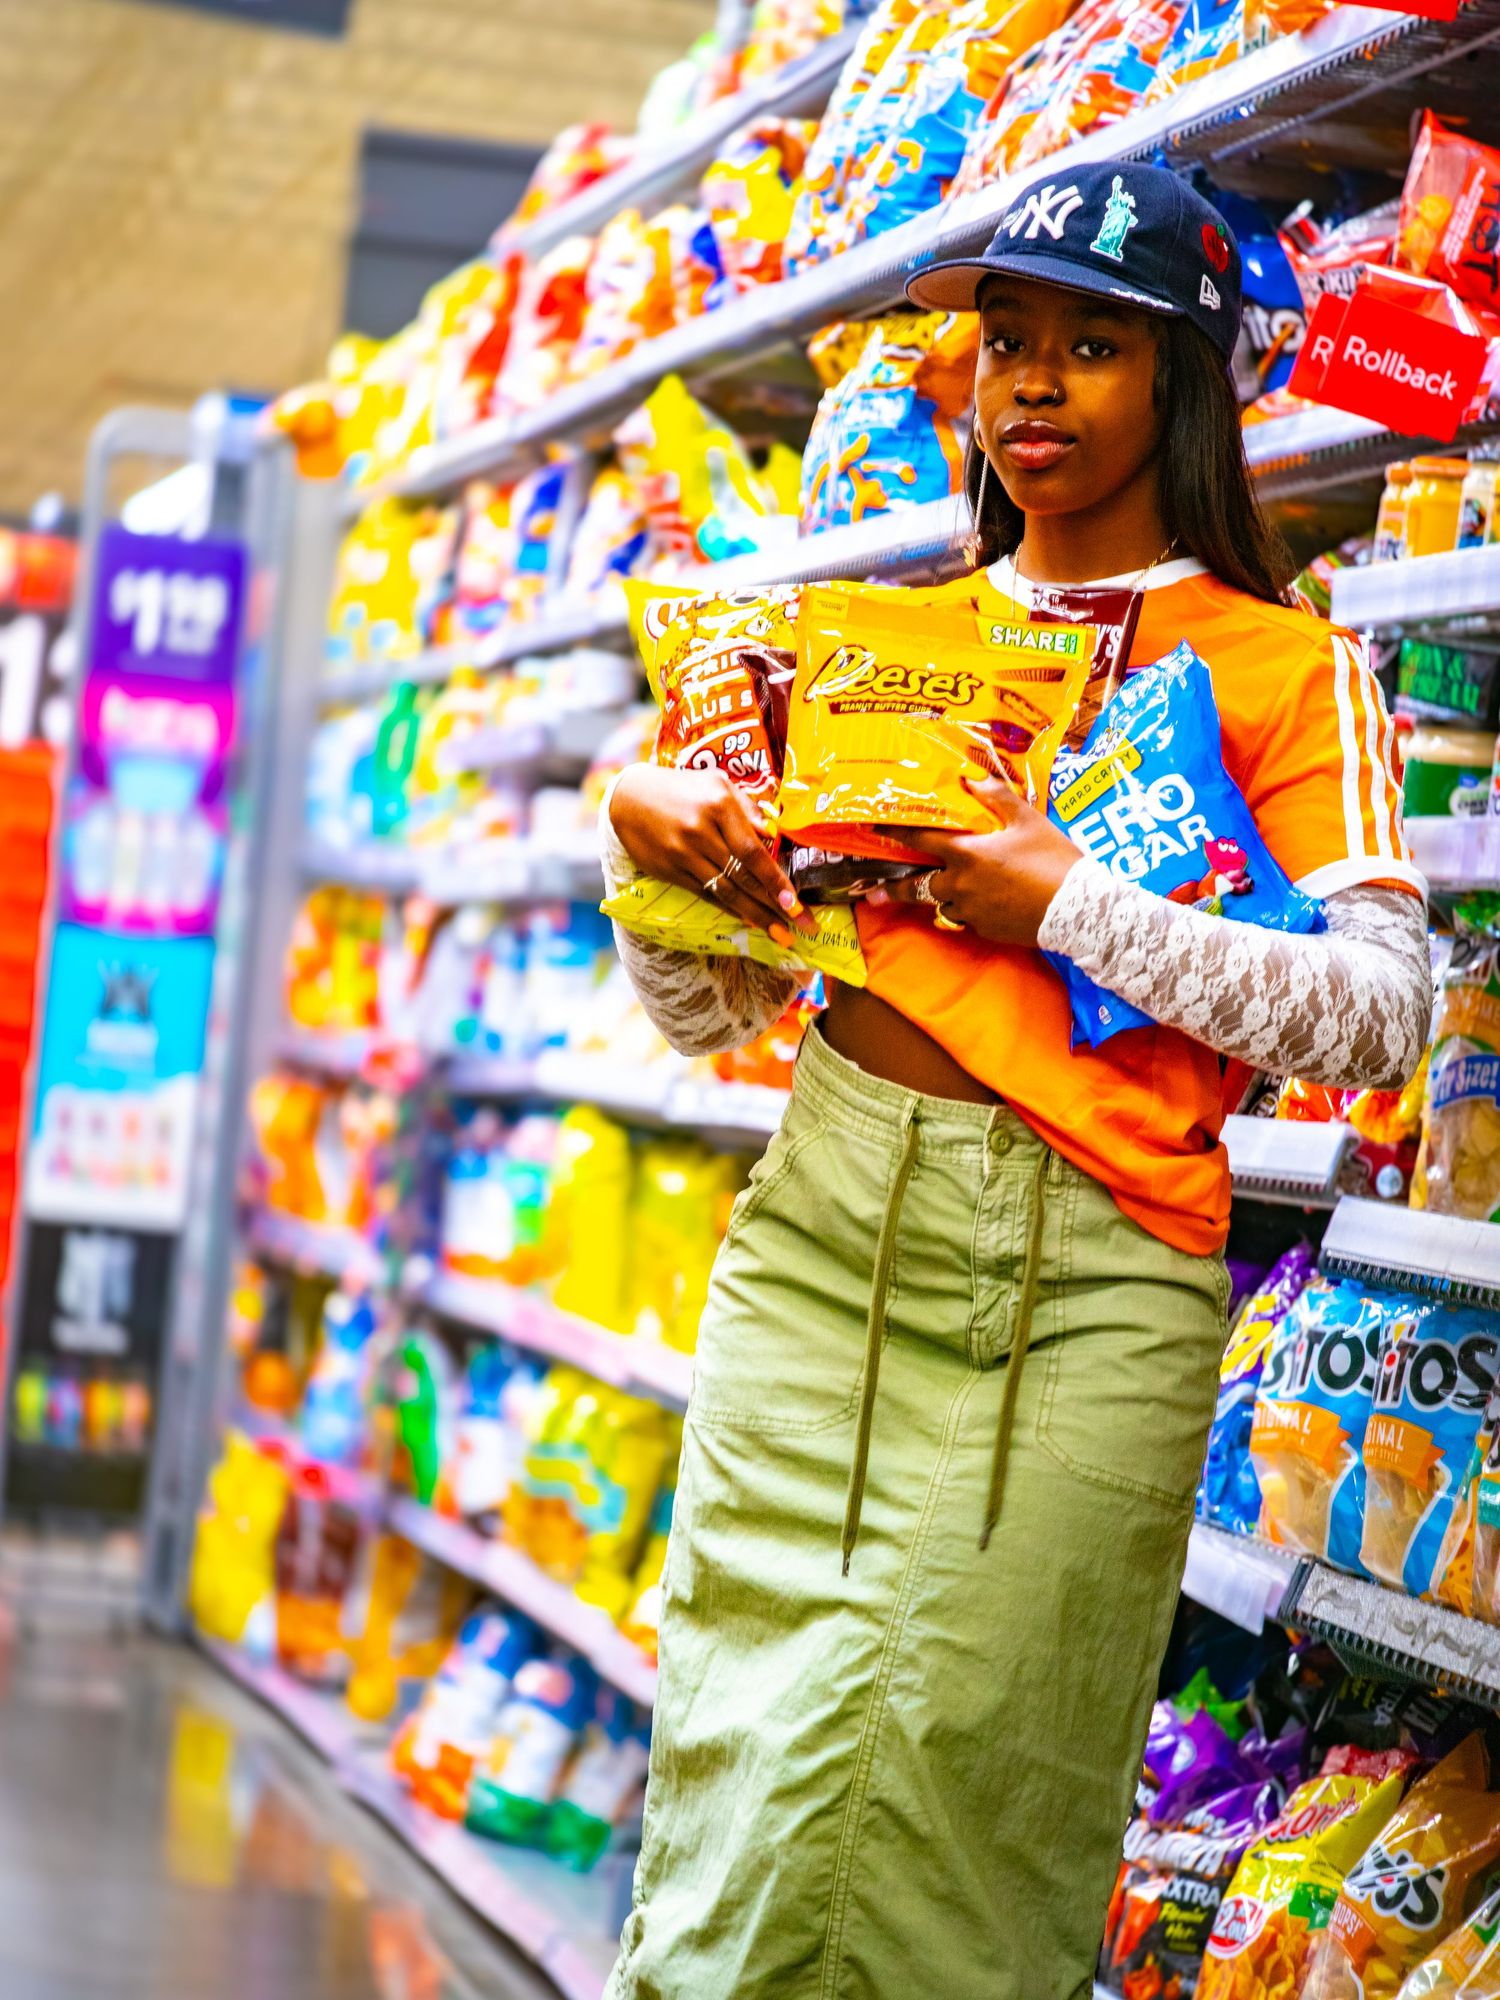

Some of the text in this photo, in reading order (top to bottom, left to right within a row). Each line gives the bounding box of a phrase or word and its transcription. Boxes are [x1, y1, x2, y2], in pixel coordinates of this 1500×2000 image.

[1008, 184, 1084, 241] NY
[1343, 334, 1458, 401] Rollback
[990, 624, 1066, 654] SHARE
[803, 645, 984, 705] Reese's
[840, 702, 872, 714] PEANUT
[875, 702, 907, 712] BUTTER
[1061, 784, 1093, 813] HARD
[1068, 773, 1195, 858] ERO
[1108, 813, 1215, 882] GAR
